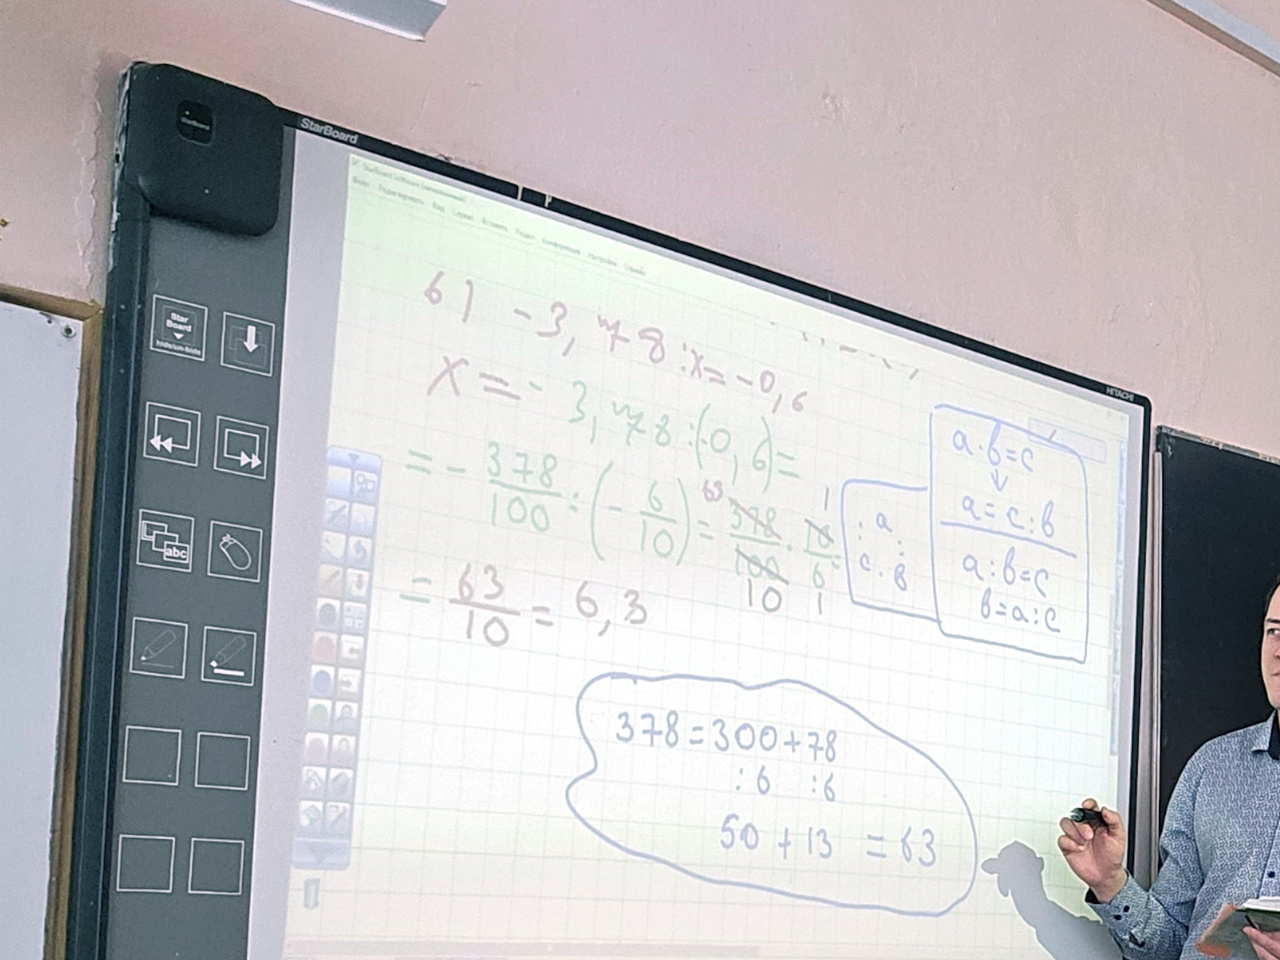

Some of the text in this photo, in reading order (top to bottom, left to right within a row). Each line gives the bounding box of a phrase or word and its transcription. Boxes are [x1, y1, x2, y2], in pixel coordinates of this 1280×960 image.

[300, 117, 358, 146] StarBoard
[170, 312, 189, 324] Star
[166, 319, 192, 334] Board
[1105, 386, 1135, 402] HITACHI
[490, 492, 551, 533] 100
[165, 547, 187, 559] abc
